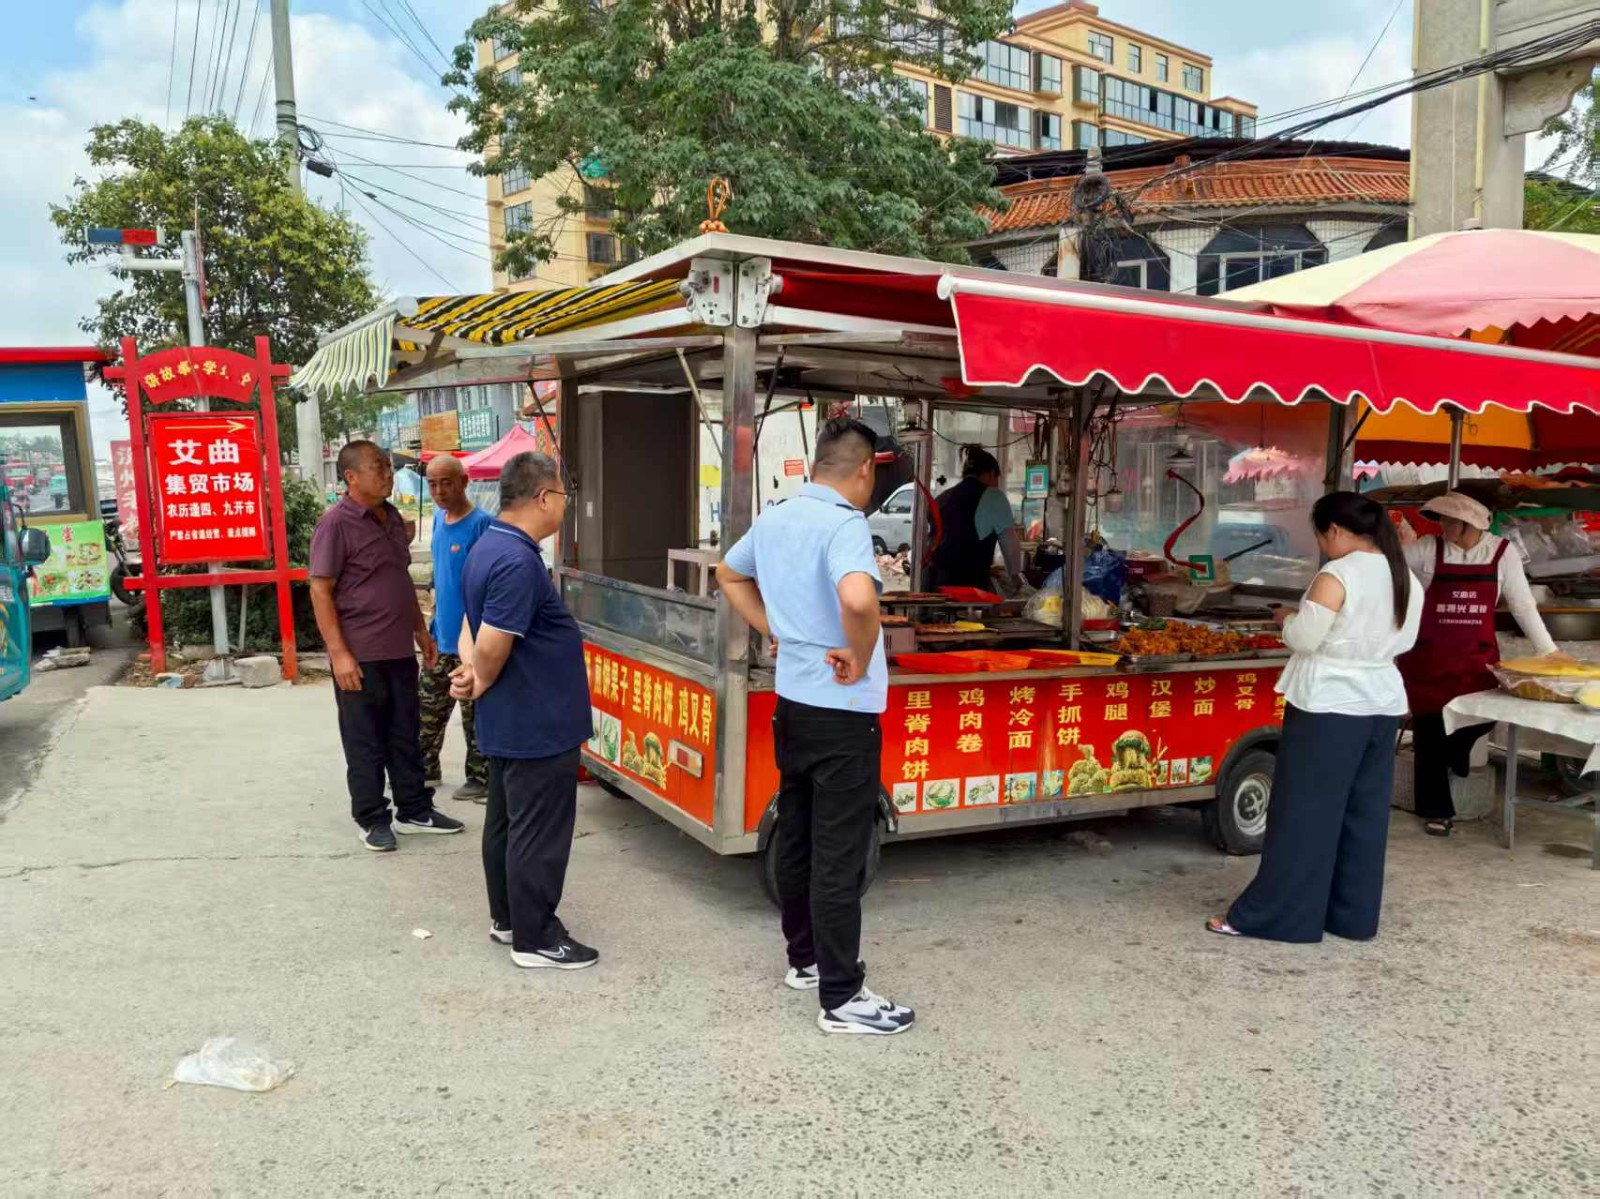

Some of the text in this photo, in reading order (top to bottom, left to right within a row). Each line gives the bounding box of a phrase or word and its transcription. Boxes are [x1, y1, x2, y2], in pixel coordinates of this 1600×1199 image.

[168, 439, 239, 465] 艾曲
[165, 472, 254, 495] 集贸市场
[632, 669, 674, 729] 里脊肉饼
[957, 689, 984, 752] 鸡肉卷
[1008, 687, 1034, 749] 烤冷面
[1056, 684, 1083, 746] 手抓饼
[1105, 683, 1128, 720] 鸡腿
[1150, 681, 1171, 717] 汉堡
[1194, 678, 1215, 716] 炒面
[901, 690, 932, 780] 里脊肉饼
